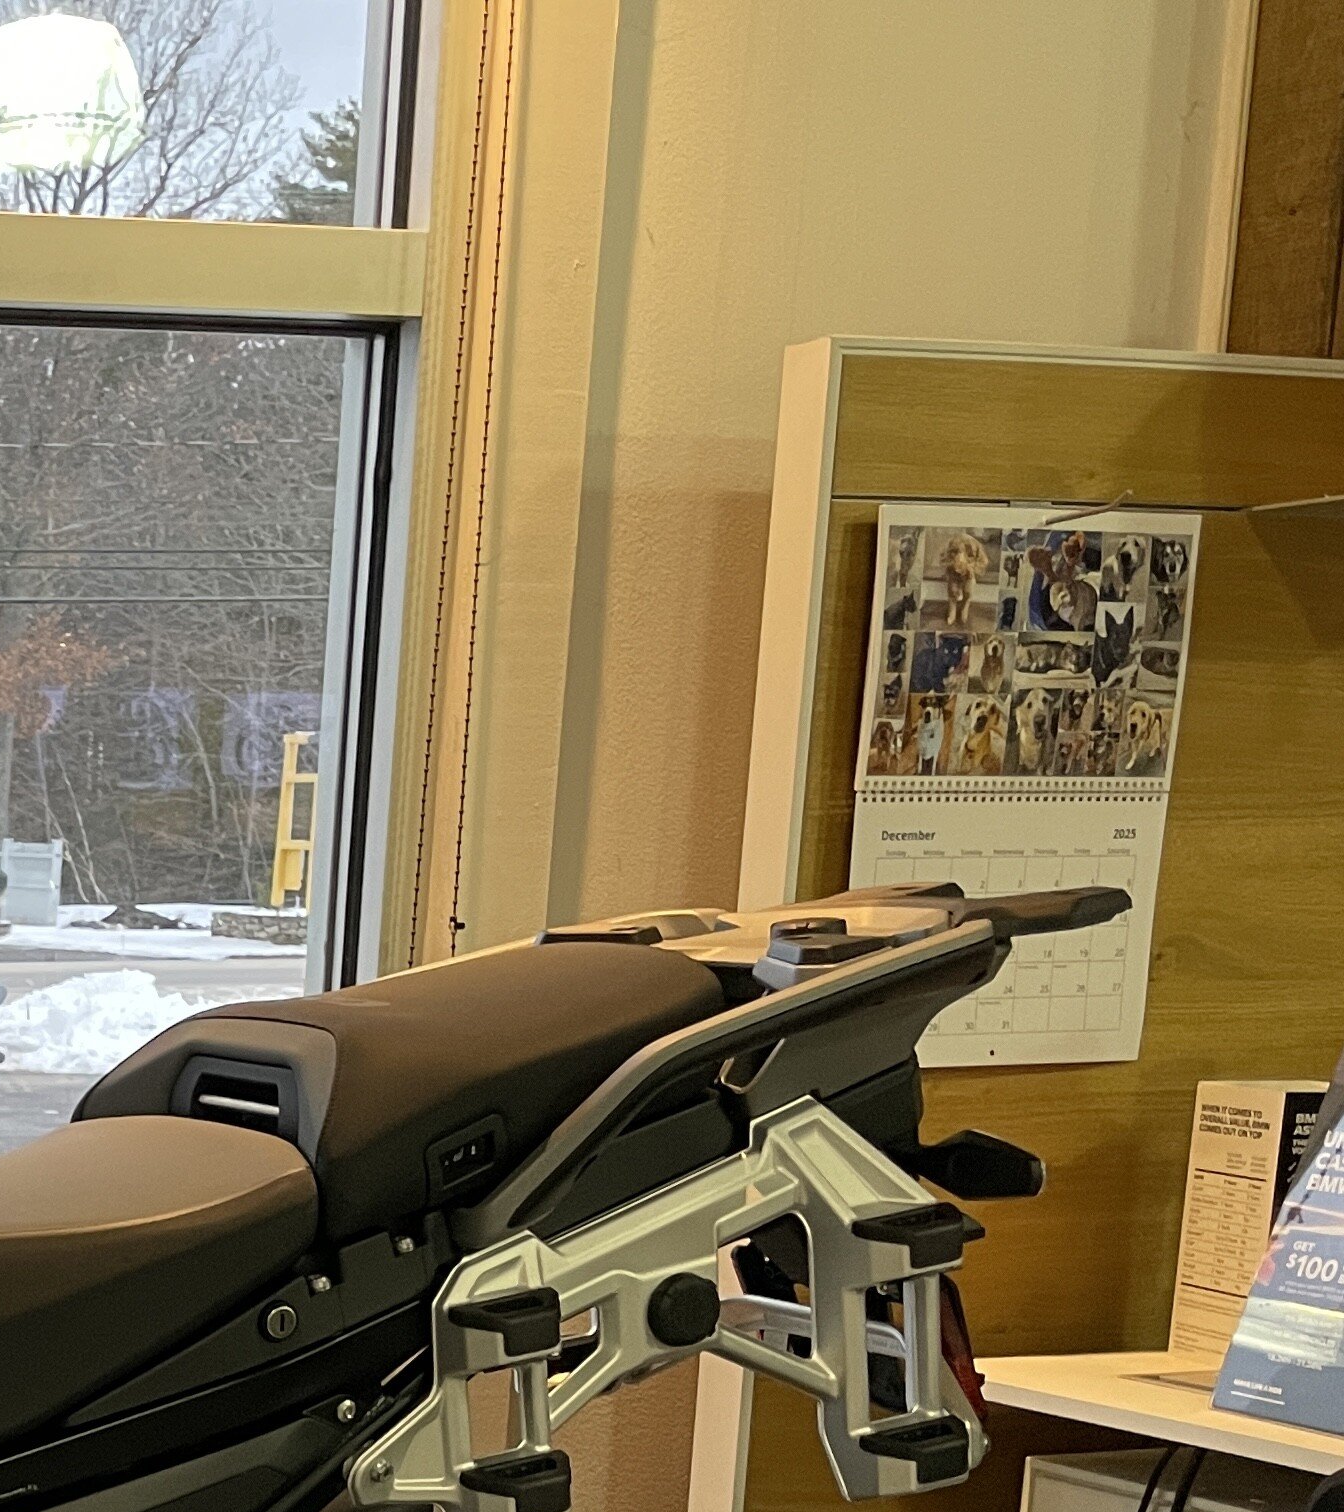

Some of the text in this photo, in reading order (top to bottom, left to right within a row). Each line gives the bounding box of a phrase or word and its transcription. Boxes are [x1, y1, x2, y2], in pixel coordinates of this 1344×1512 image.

[880, 828, 1137, 842] December 2025
[1293, 1240, 1317, 1253] GET
[1285, 1252, 1339, 1282] $100
